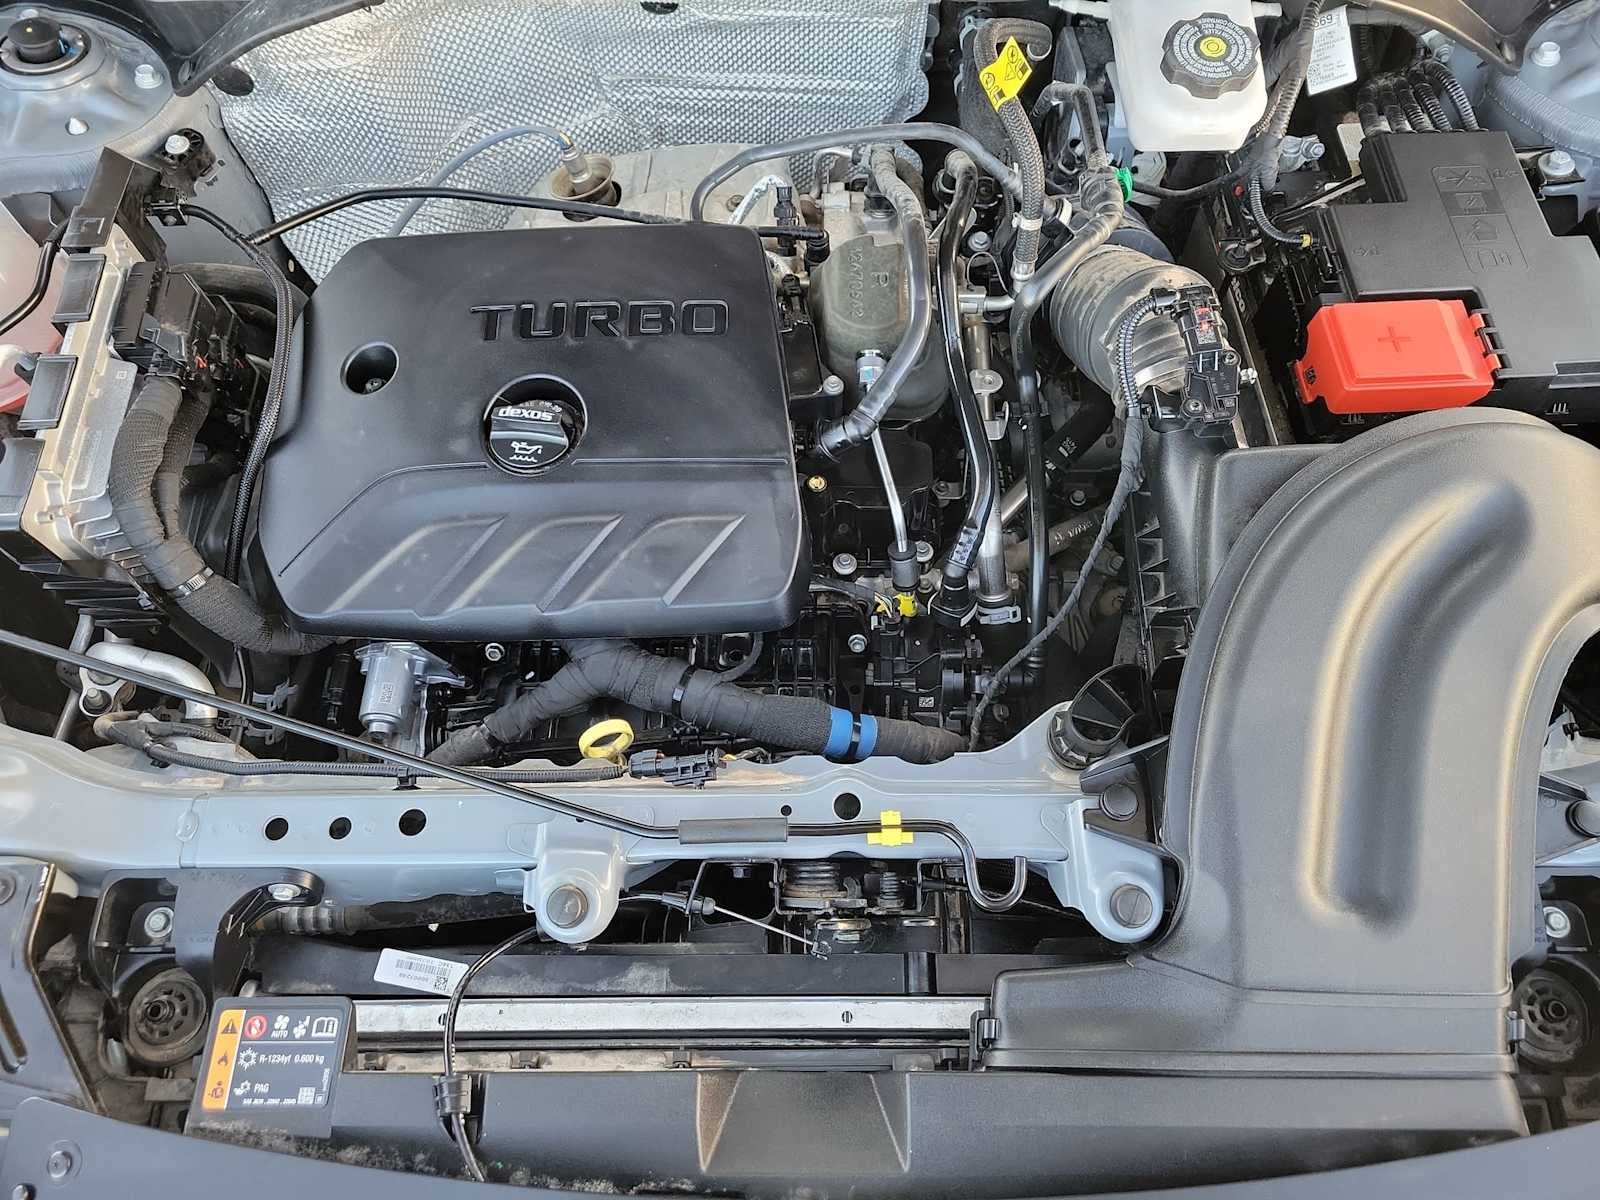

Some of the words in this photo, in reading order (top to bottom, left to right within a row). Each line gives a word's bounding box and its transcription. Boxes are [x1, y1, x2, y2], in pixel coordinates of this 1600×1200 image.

[470, 299, 729, 341] TURBO
[498, 405, 555, 422] dexos
[270, 1029, 289, 1039] AUTO
[259, 1054, 291, 1065] R-1234yf
[315, 1054, 325, 1065] kg
[254, 1083, 270, 1094] PAG
